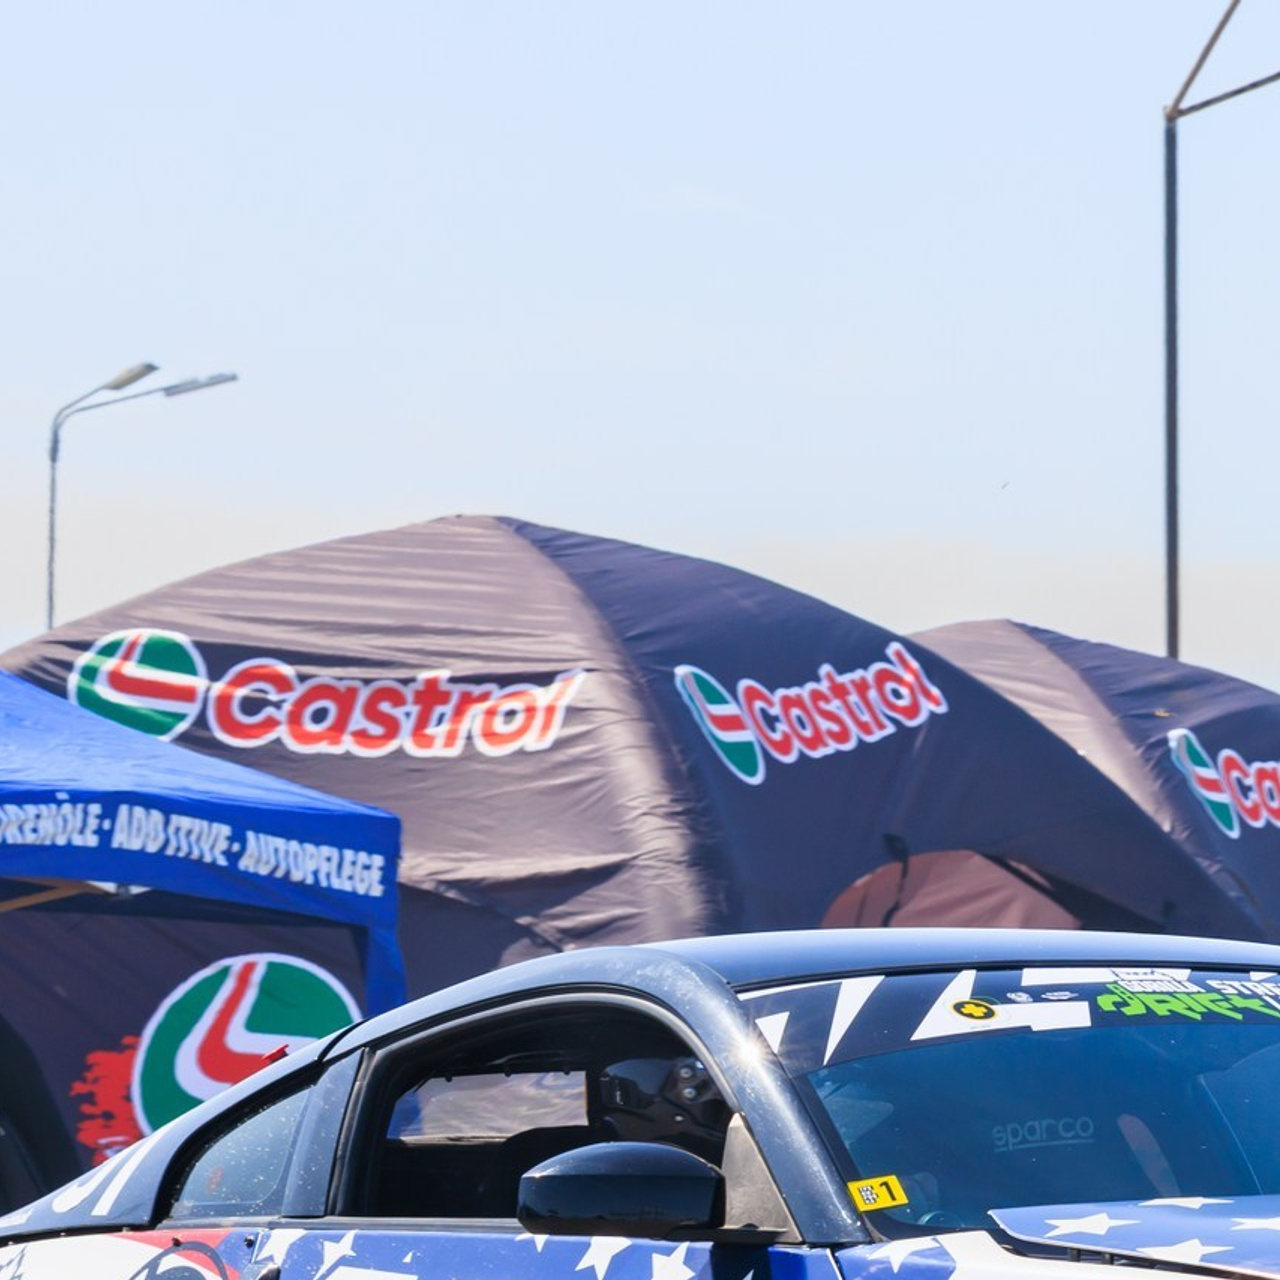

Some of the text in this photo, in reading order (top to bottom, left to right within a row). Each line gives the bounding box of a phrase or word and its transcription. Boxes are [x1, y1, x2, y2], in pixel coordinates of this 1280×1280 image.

[207, 658, 586, 757] Castrol
[736, 641, 949, 763] Castrol
[238, 830, 386, 897] AUTOPFLEGE
[992, 1116, 1094, 1152] sparco
